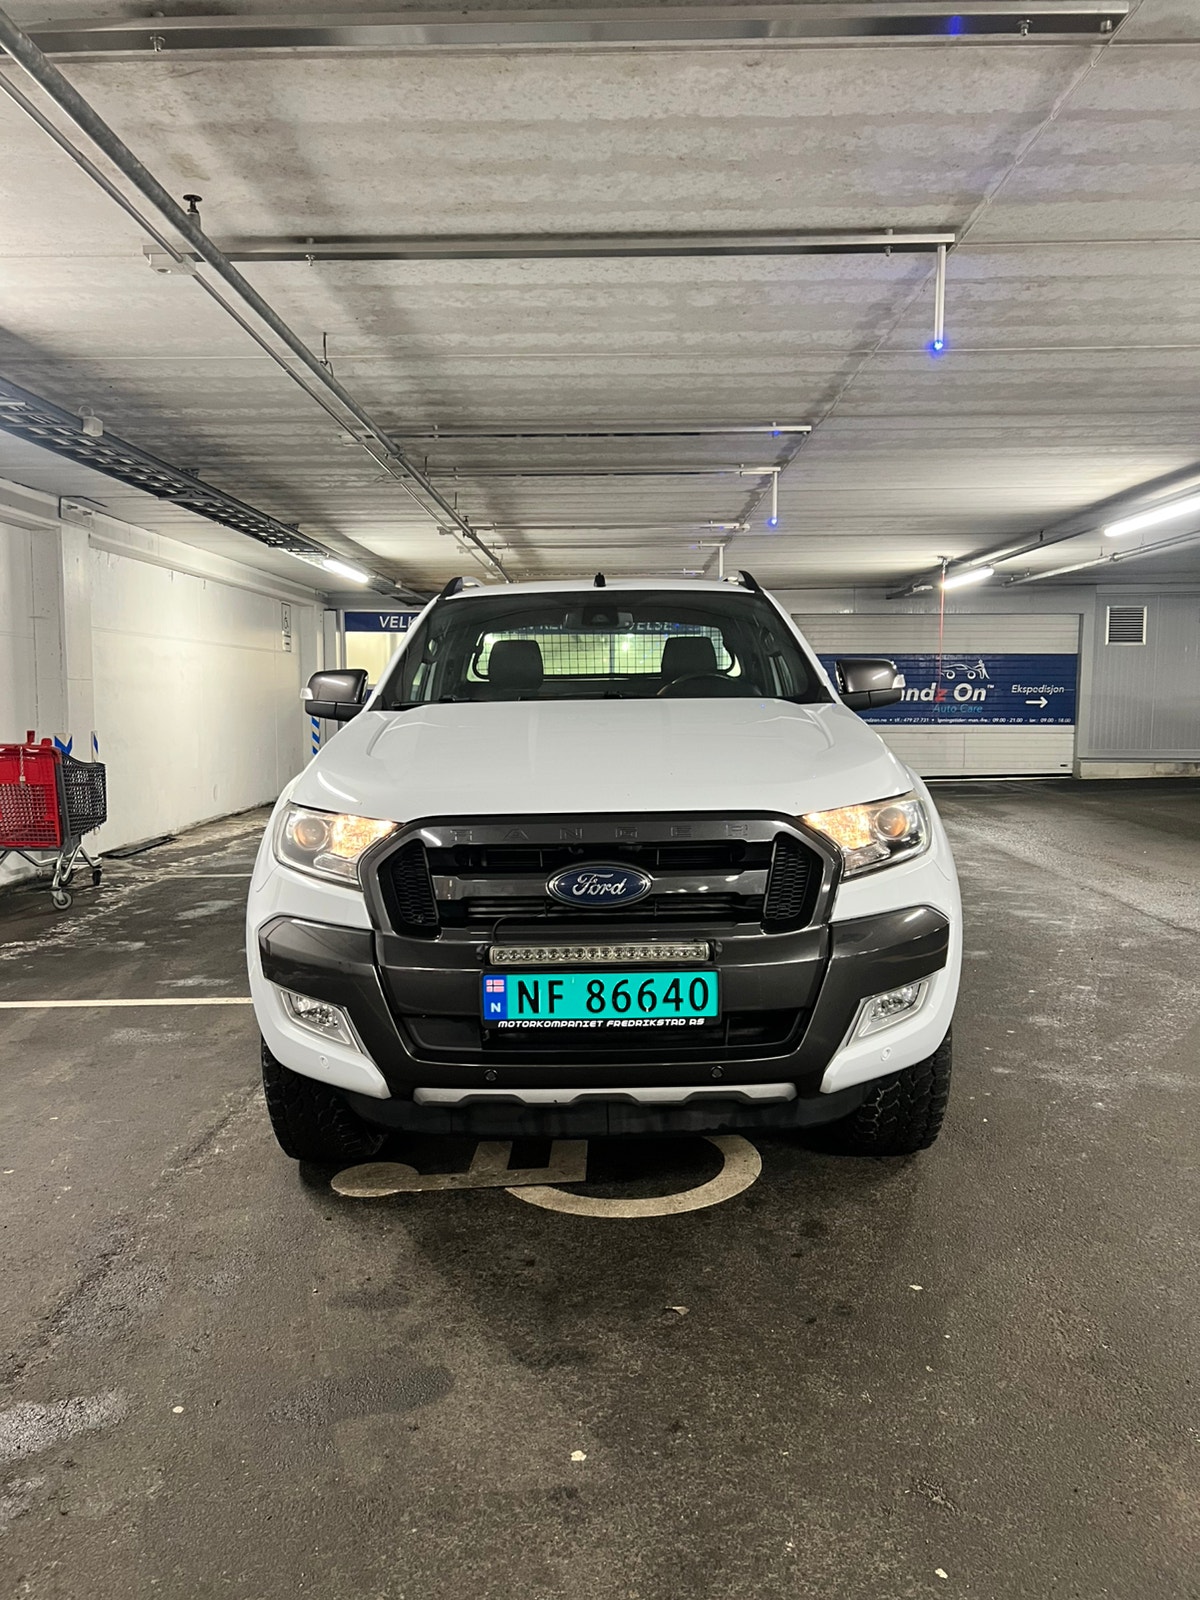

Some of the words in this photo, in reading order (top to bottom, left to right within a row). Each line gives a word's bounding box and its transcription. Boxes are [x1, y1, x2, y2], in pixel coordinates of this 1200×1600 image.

[1011, 684, 1065, 695] Ekspedisjon
[932, 704, 958, 713] Auto
[959, 704, 984, 713] Care
[450, 824, 748, 842] RANGER
[572, 872, 628, 896] Ford
[518, 980, 564, 1014] NF
[586, 977, 709, 1014] 86640
[490, 1002, 502, 1013] N
[498, 1020, 604, 1028] MOTORKOMPANIET
[606, 1018, 687, 1028] FREDRIKSTAD
[689, 1017, 706, 1026] AS
